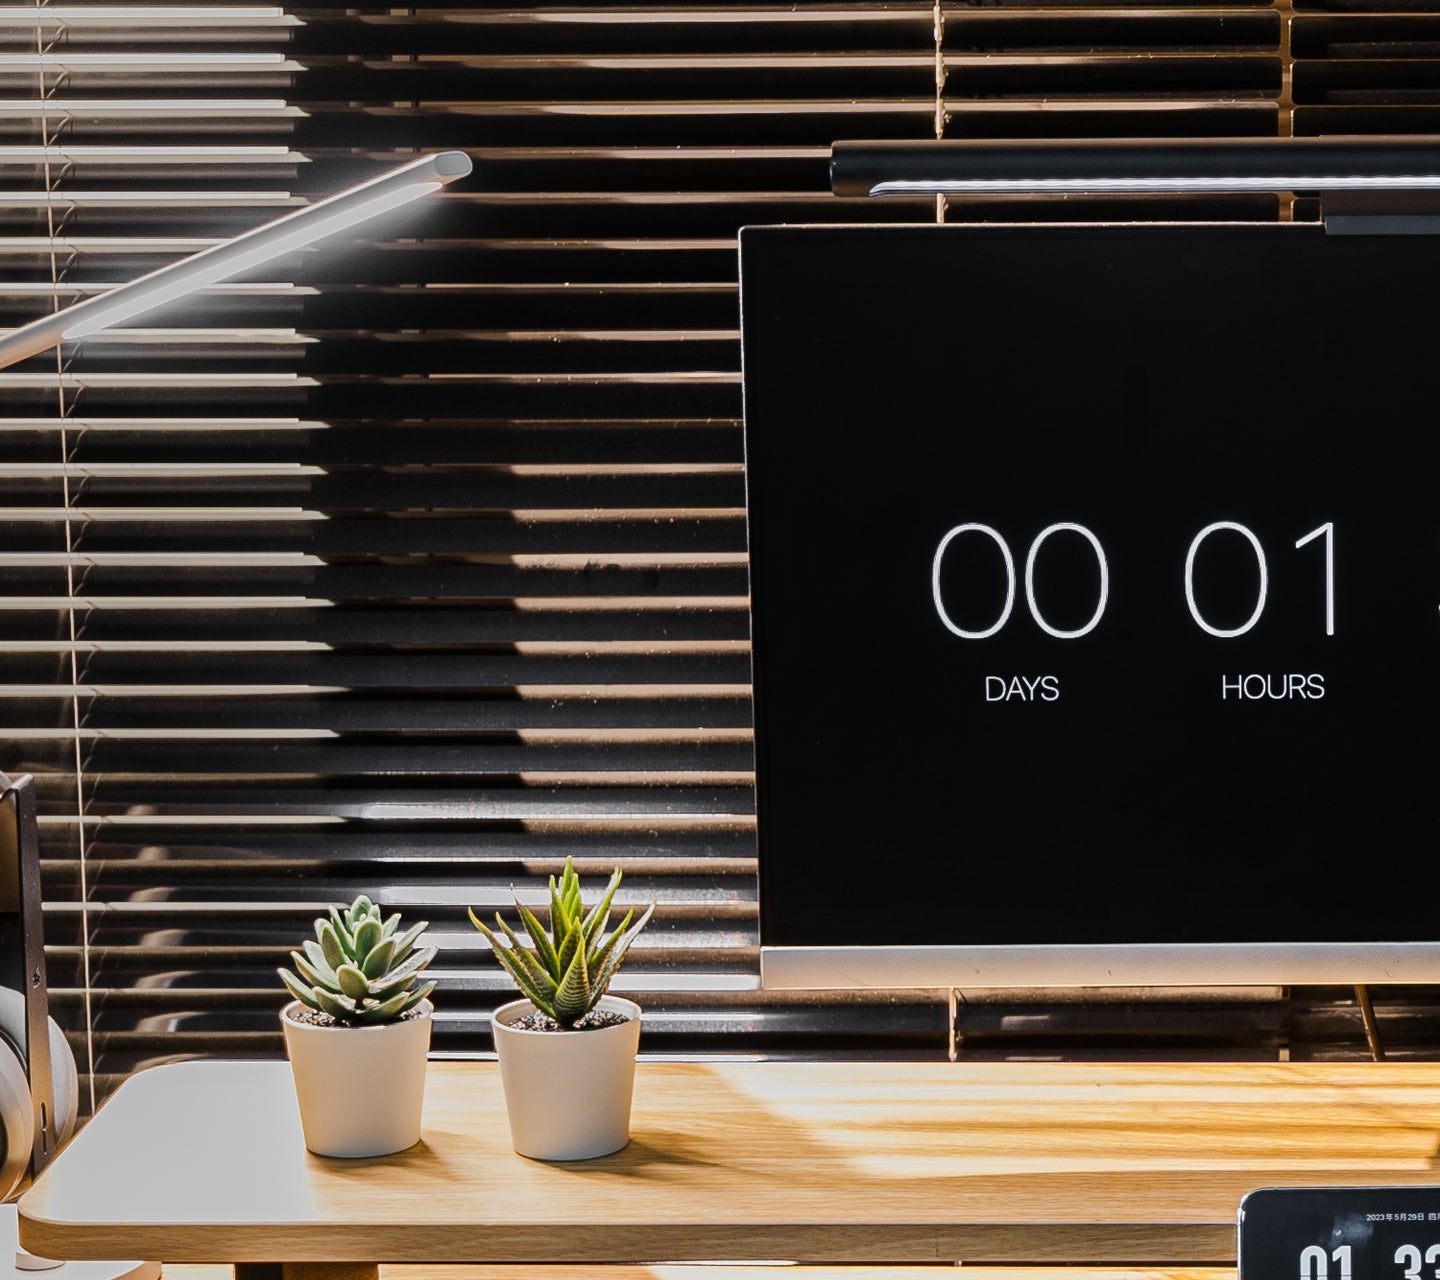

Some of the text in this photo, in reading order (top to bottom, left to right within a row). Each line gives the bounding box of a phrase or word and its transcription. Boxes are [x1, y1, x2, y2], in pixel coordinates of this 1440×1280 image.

[931, 522, 1109, 639] 00
[1184, 520, 1335, 638] 01
[985, 675, 1060, 702] DAYS
[1222, 673, 1325, 700] HOURS
